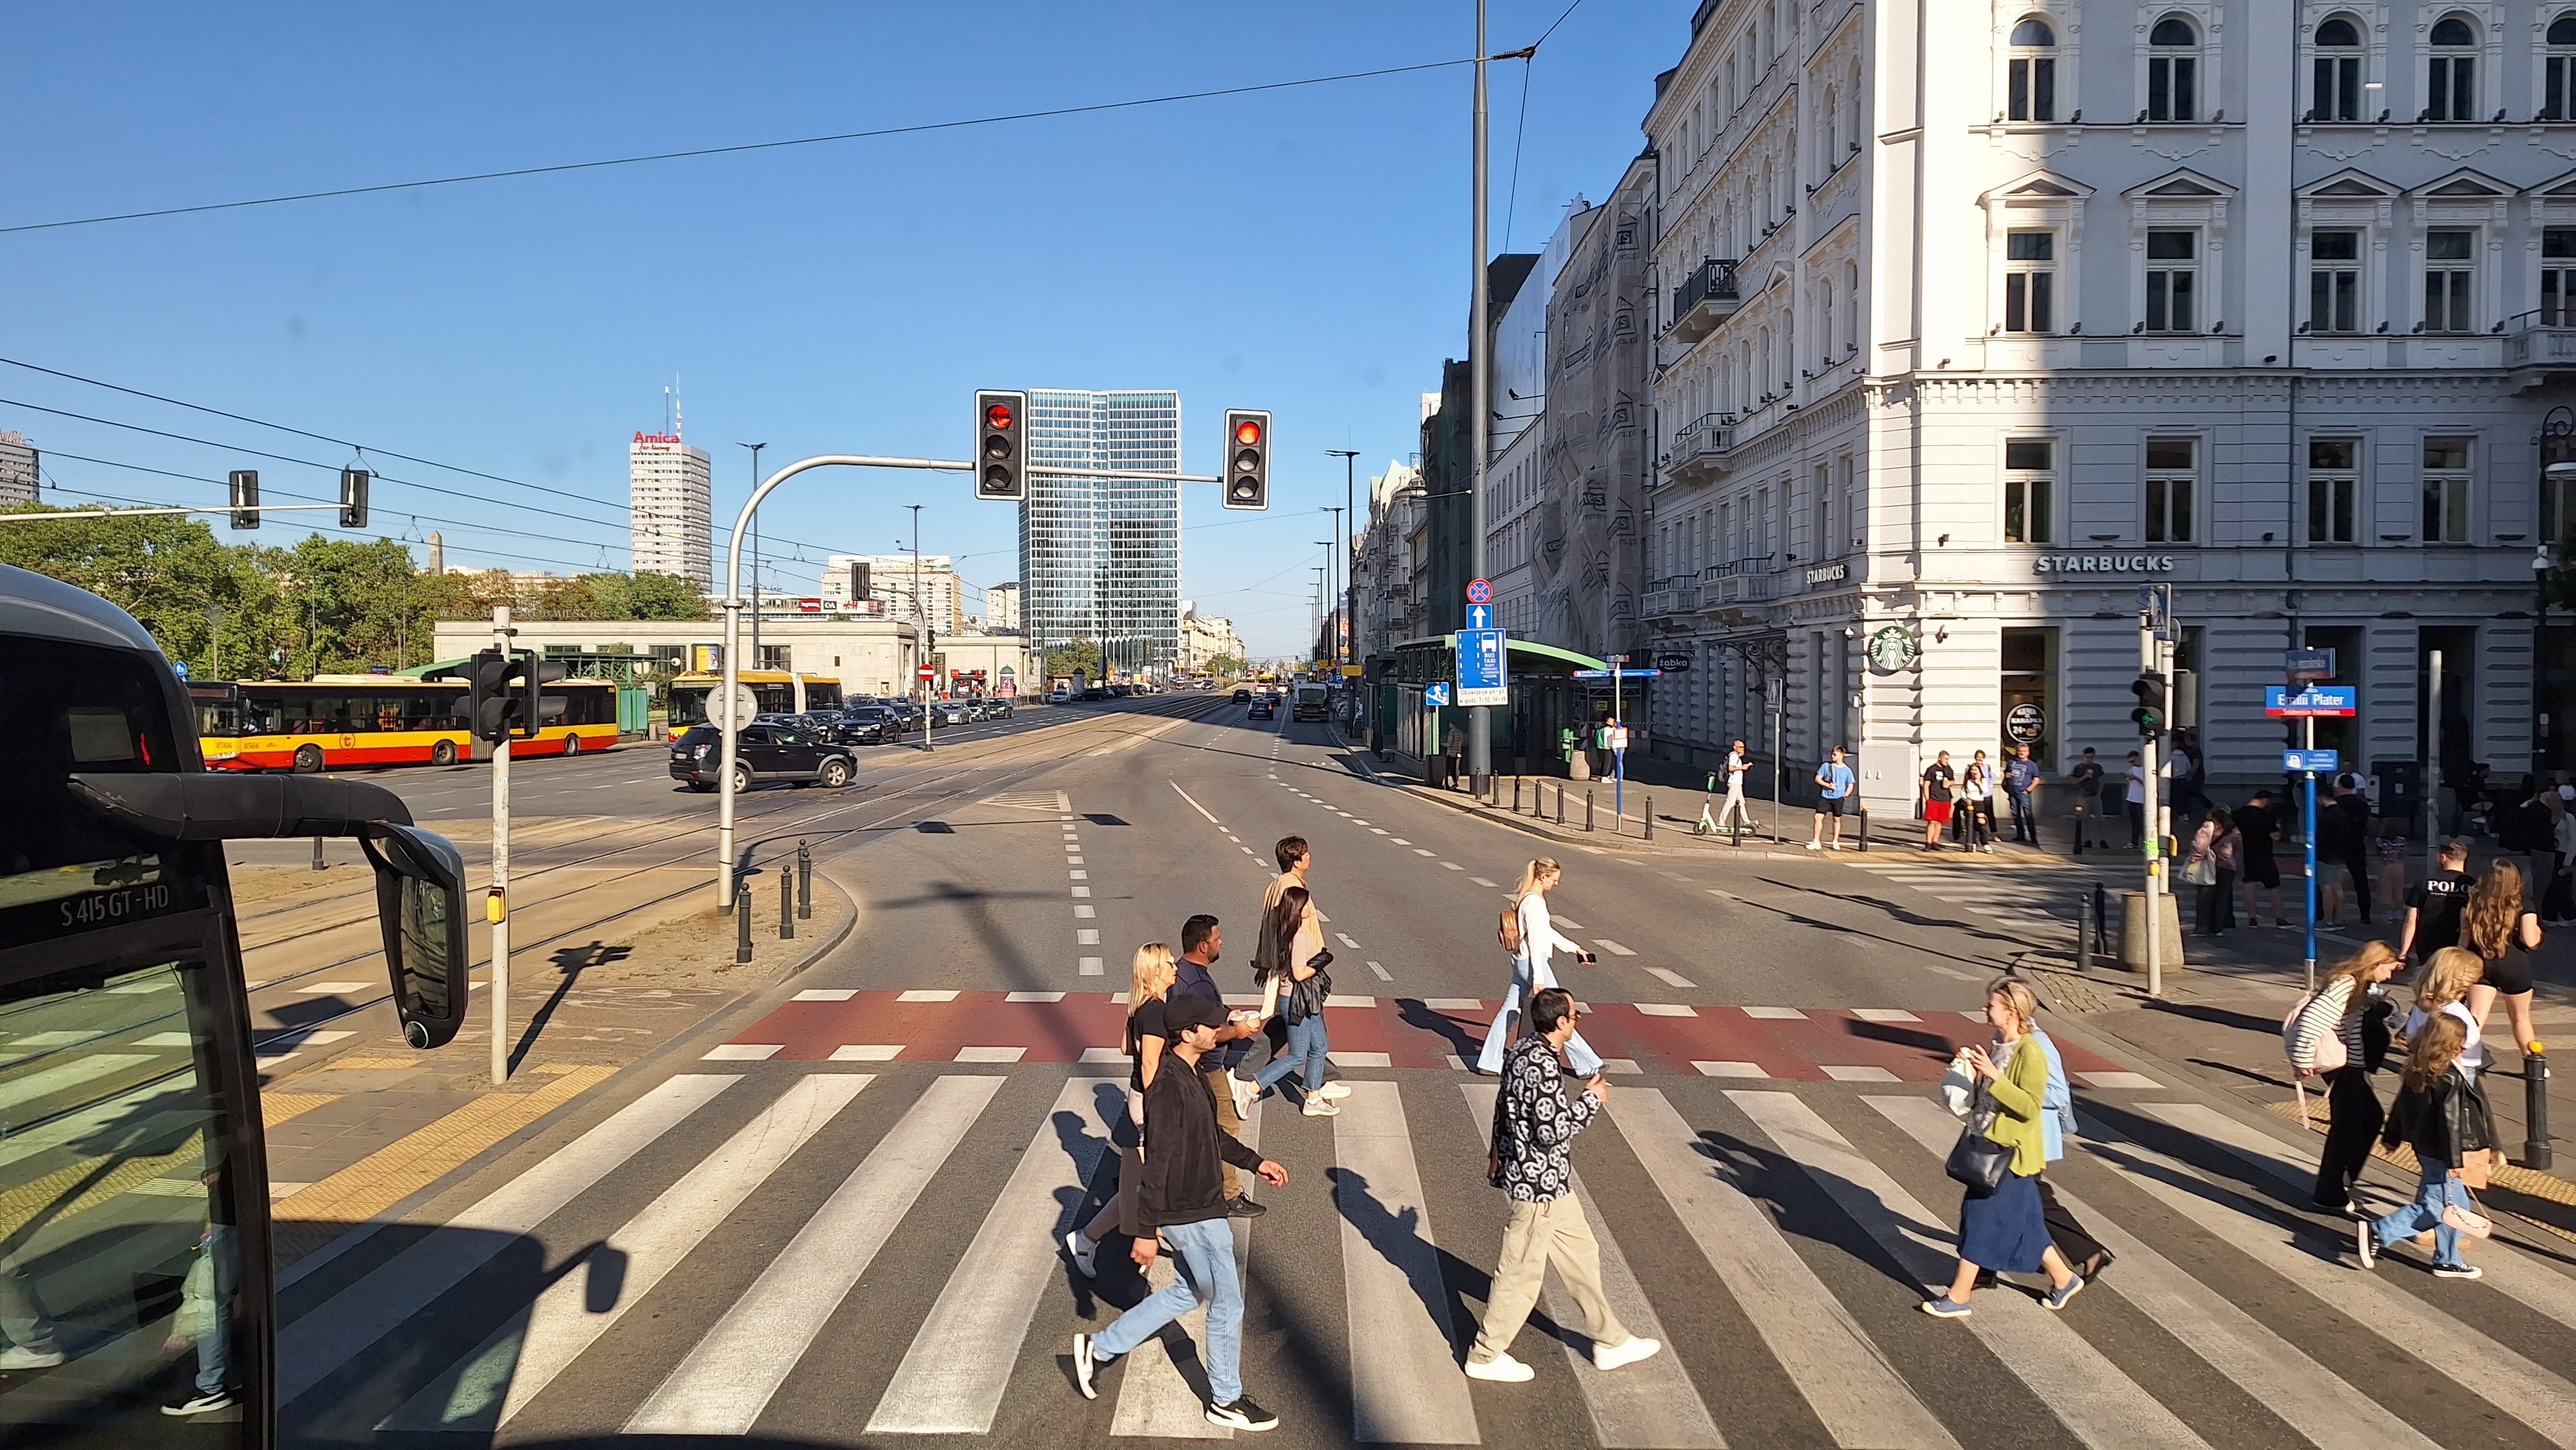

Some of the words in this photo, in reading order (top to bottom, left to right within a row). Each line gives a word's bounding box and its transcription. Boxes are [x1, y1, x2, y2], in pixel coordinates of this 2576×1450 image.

[633, 431, 681, 443] Amica
[2037, 555, 2175, 572] STARBUCKS
[1806, 564, 1844, 585] STARBUCKS
[1659, 659, 1687, 667] żabka
[2312, 693, 2344, 706] Plater
[60, 902, 72, 927] S
[77, 895, 105, 923] 415
[109, 884, 169, 917] GT-HD
